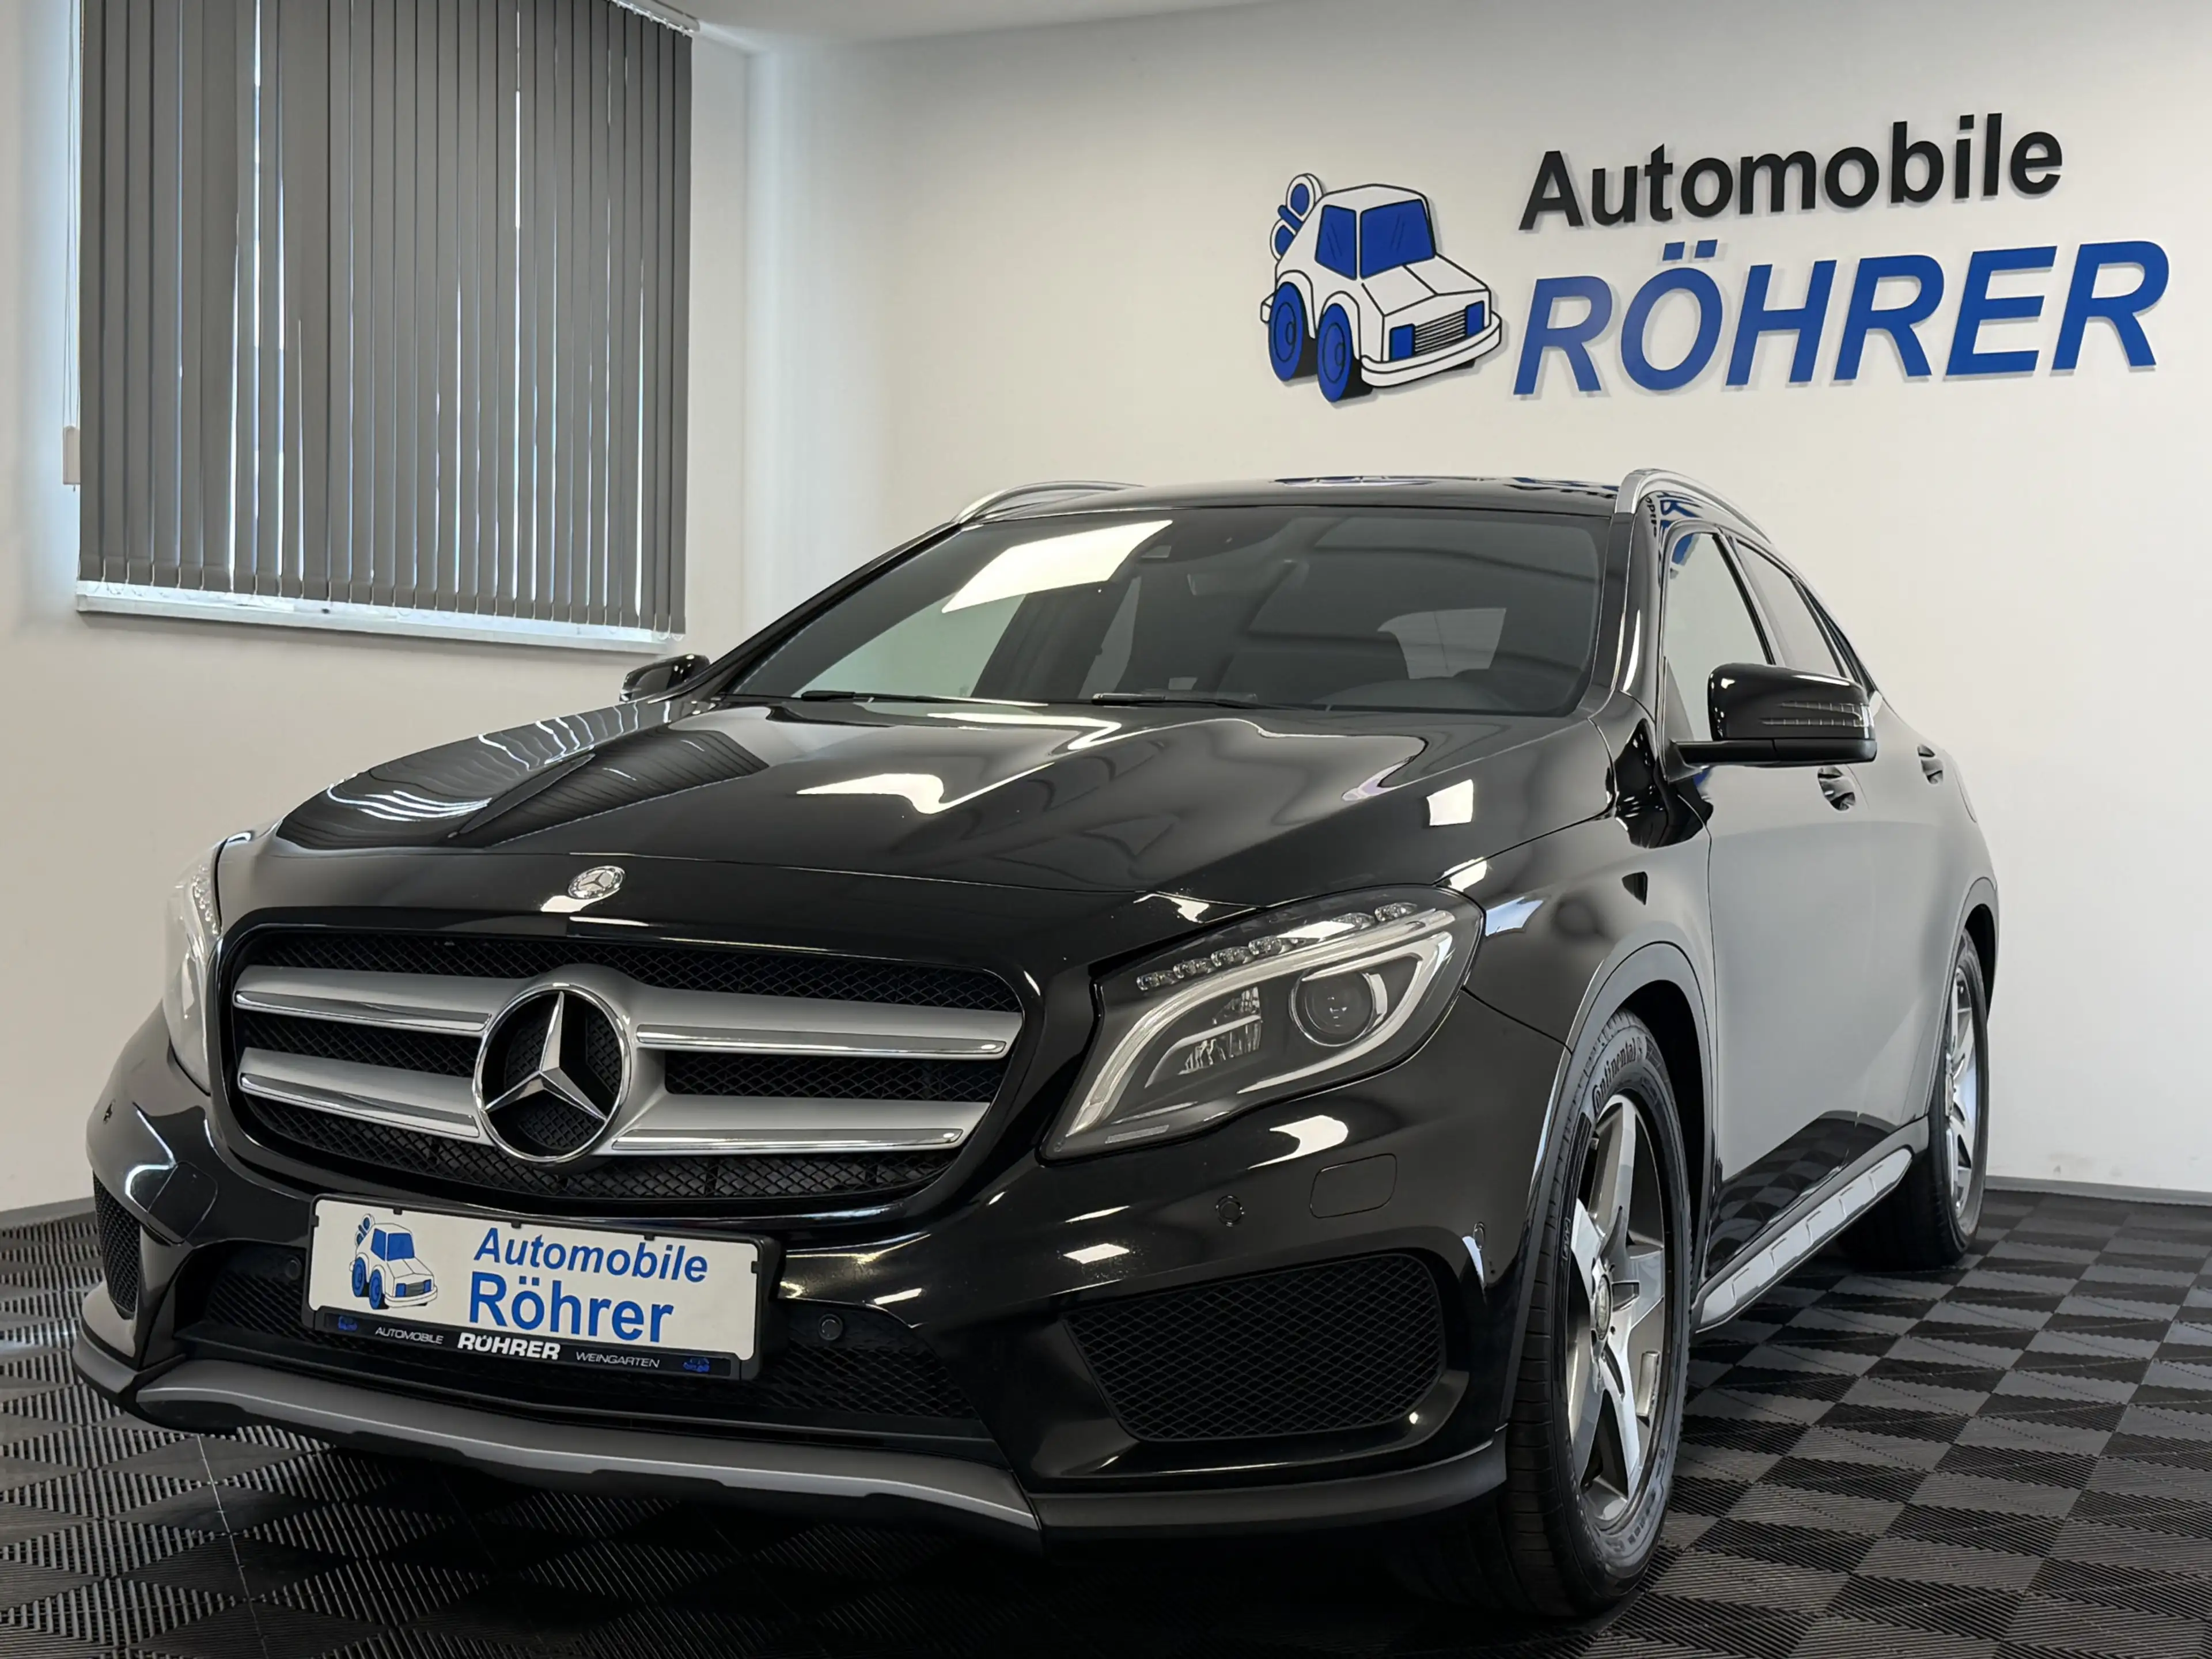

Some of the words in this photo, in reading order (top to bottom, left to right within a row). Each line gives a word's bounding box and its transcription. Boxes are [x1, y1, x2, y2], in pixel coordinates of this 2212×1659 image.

[1518, 112, 2063, 231] Automobile
[1514, 240, 2169, 395] RÖHRER
[474, 1228, 707, 1282] Automobile
[469, 1271, 674, 1343] Röhrer
[374, 1326, 444, 1344] AUTOMOBILE
[457, 1332, 561, 1361] RÖHRER
[576, 1351, 660, 1368] WEINGARTEN
